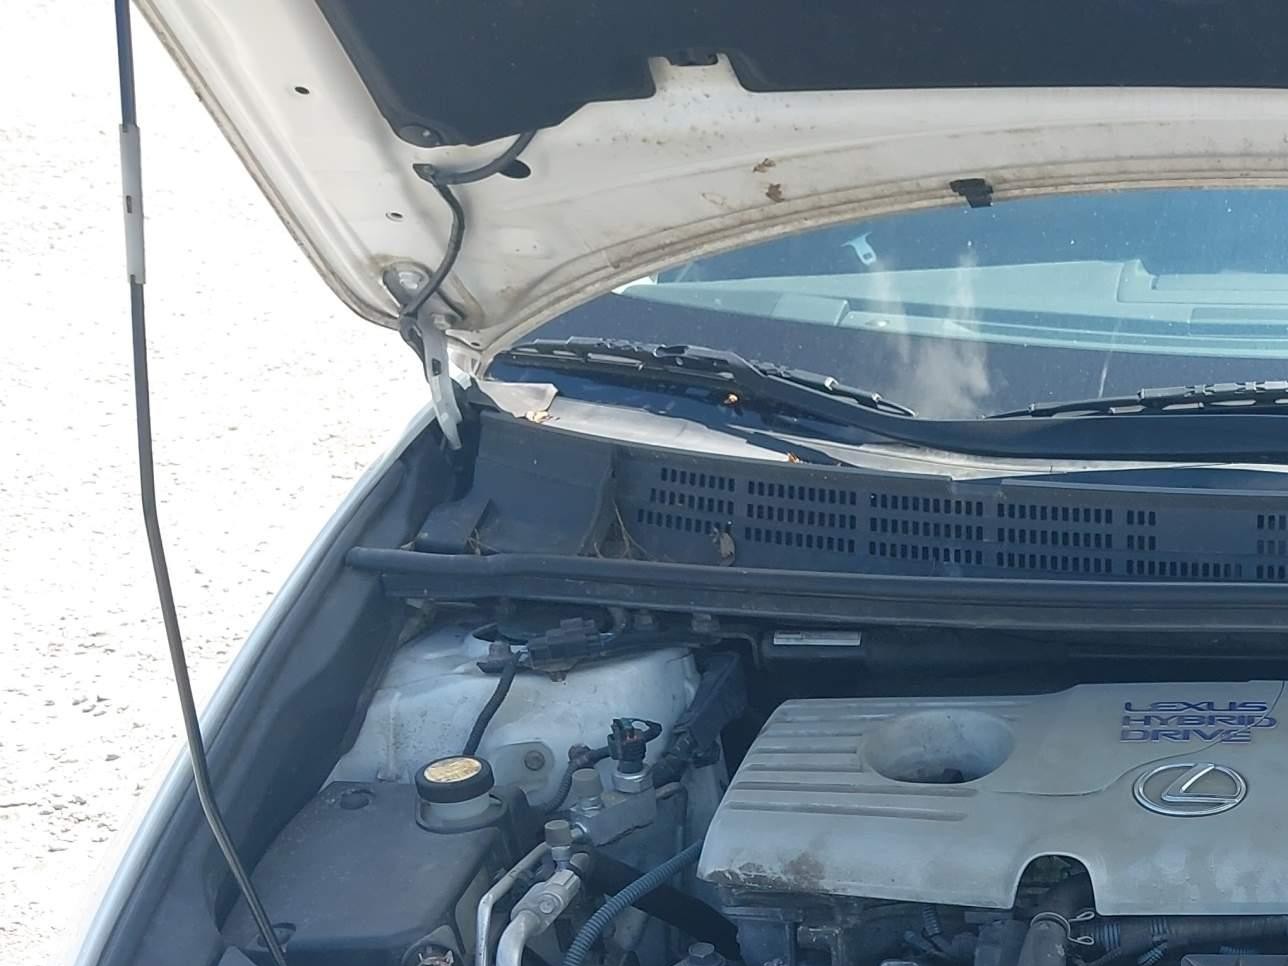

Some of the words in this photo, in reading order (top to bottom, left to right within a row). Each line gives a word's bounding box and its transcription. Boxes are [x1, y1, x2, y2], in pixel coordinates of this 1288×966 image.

[1124, 701, 1269, 713] LEXUS
[1121, 714, 1278, 728] HYBRID
[1120, 729, 1252, 743] DRIVE
